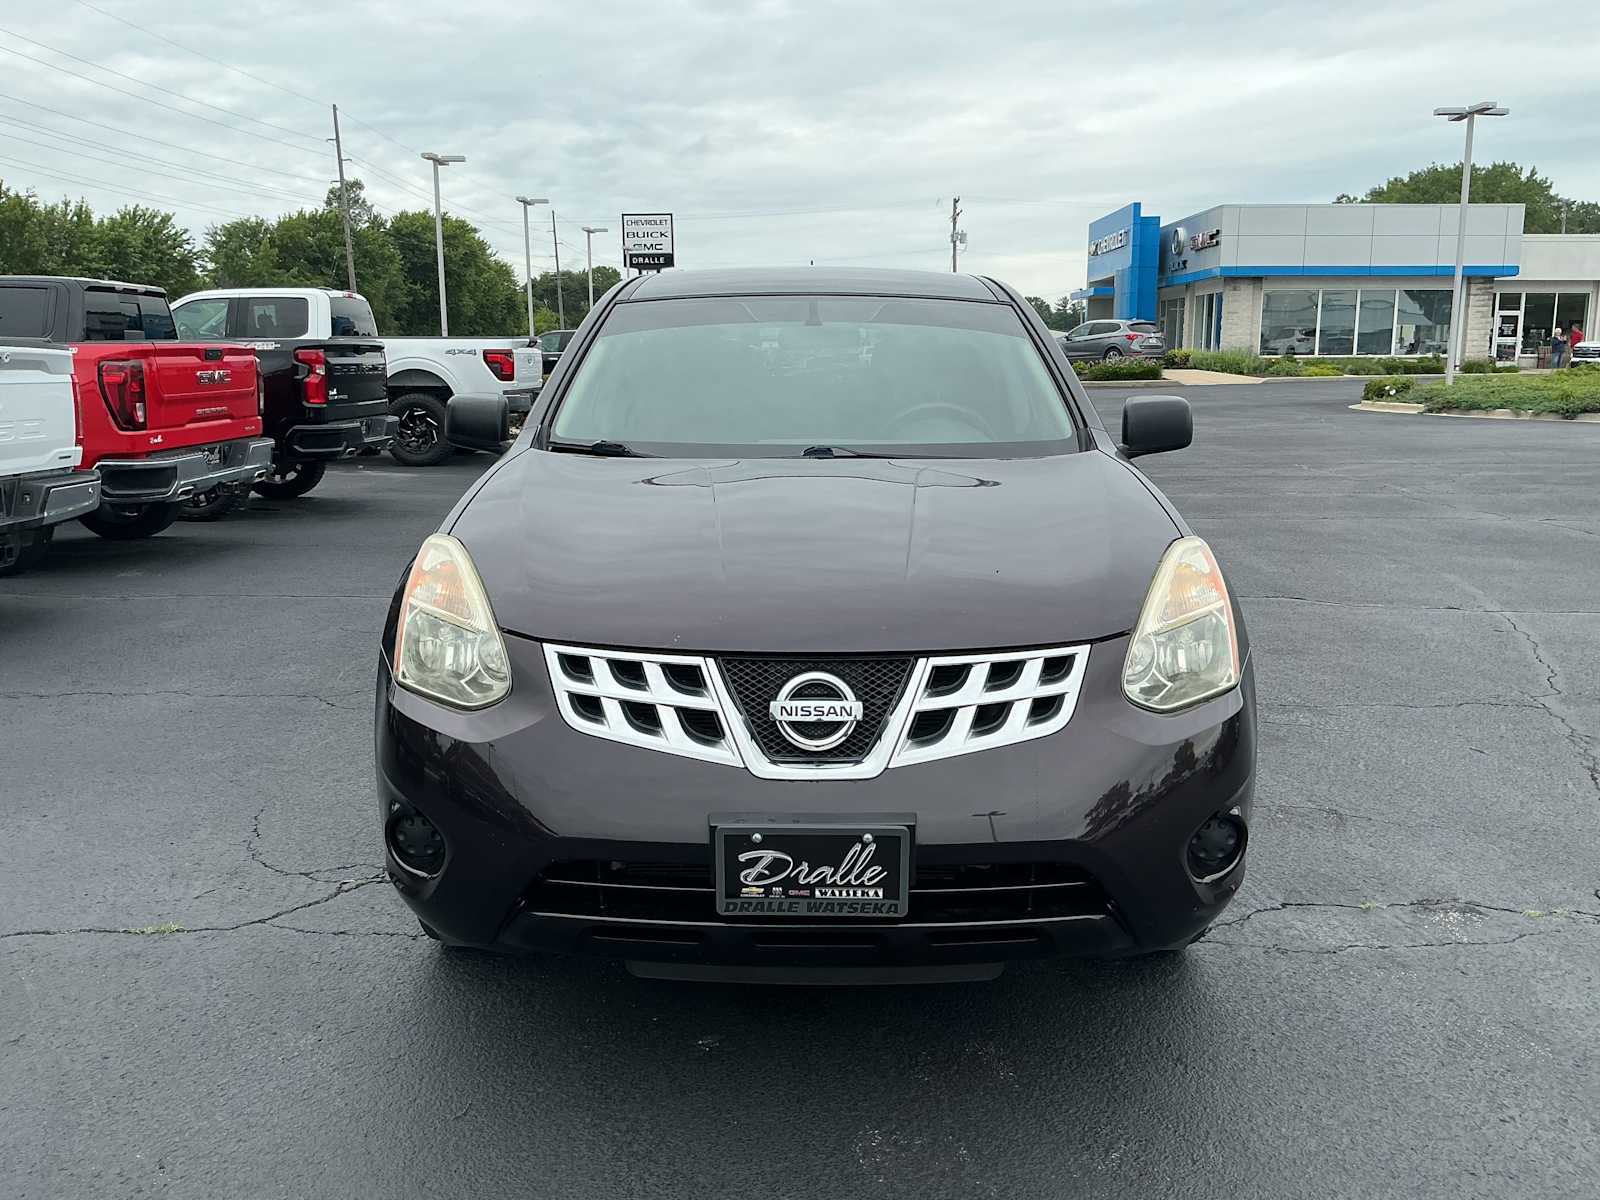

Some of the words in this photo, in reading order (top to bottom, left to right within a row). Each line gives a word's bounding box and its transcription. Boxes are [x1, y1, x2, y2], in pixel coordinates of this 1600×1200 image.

[626, 231, 669, 239] BUICK
[632, 256, 665, 264] DRALLE
[780, 705, 853, 717] NISSAN
[738, 842, 888, 886] Dralle
[815, 888, 883, 898] WATSEKA
[723, 901, 799, 913] DRALLE
[806, 901, 899, 914] WATSEKA
